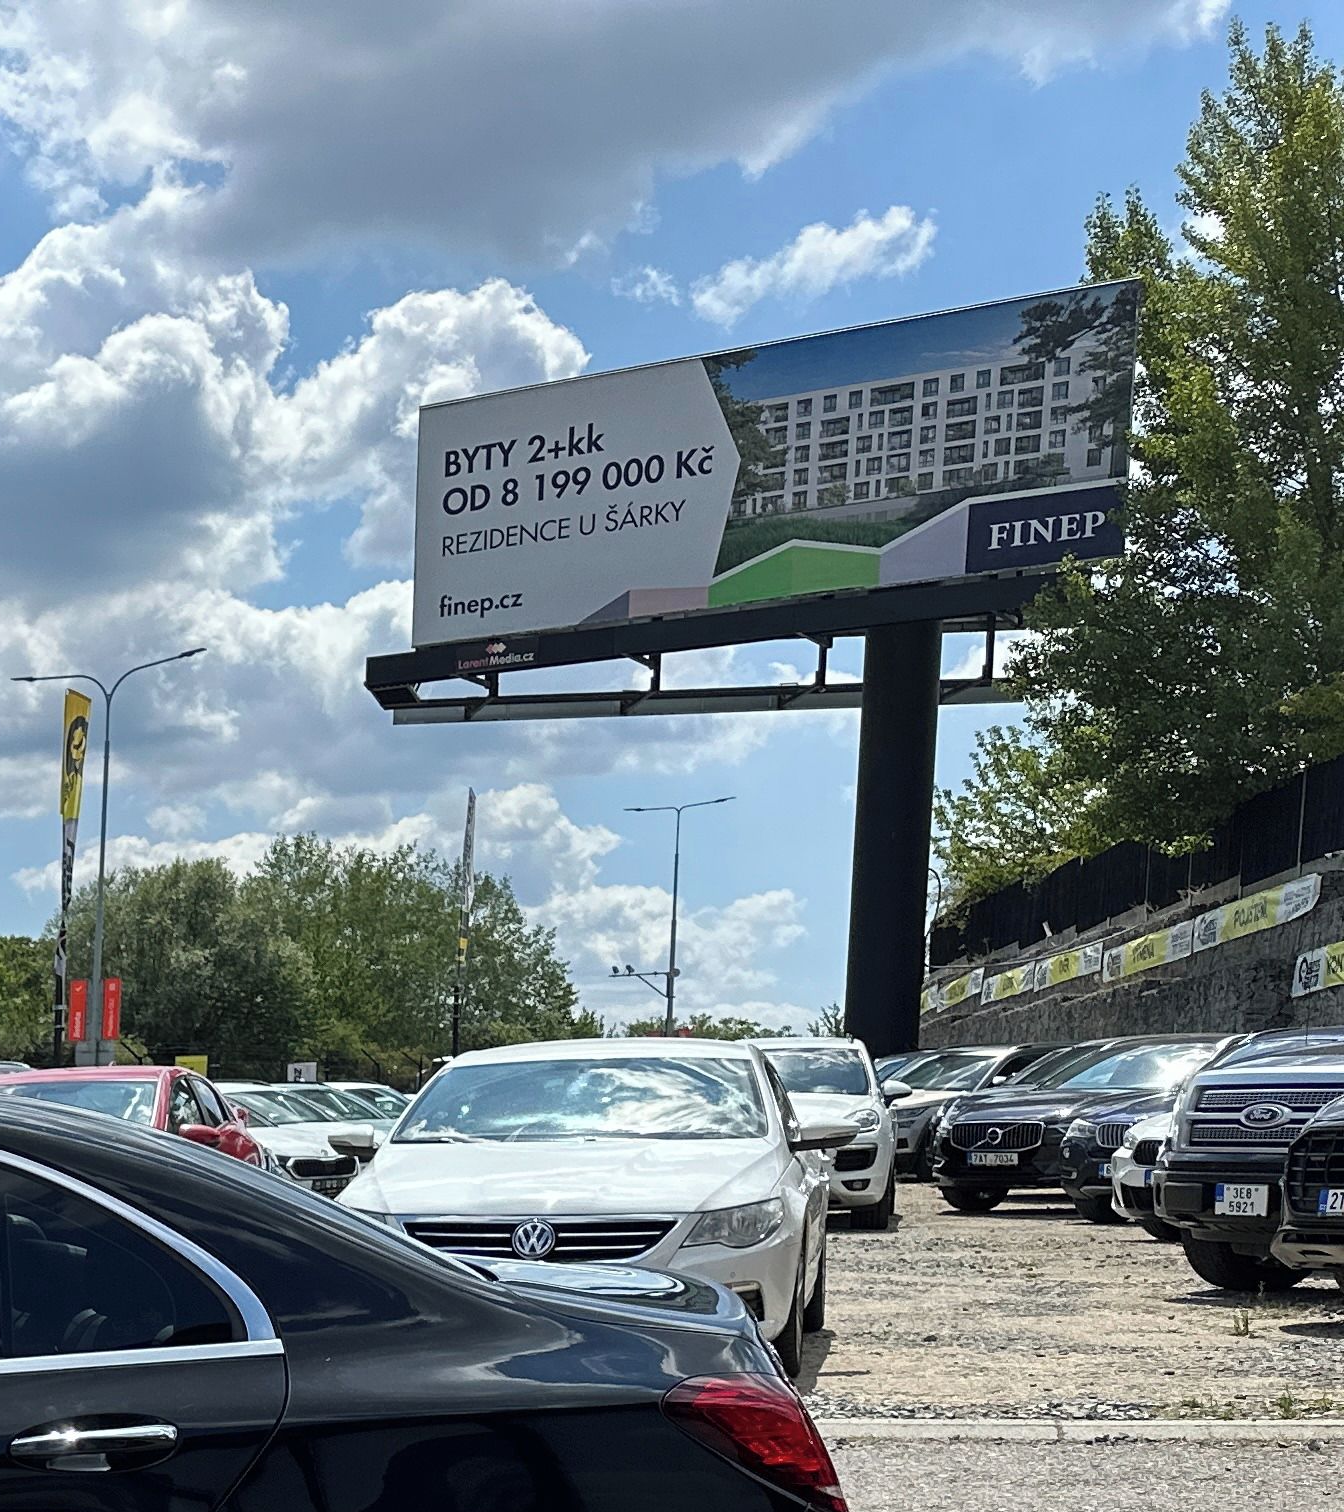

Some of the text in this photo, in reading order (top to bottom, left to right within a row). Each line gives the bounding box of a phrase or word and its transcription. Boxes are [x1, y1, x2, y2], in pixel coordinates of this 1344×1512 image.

[444, 422, 605, 478] BYTY 2+kk
[442, 445, 715, 516] OD 8 199 000 Kč
[441, 499, 687, 557] REZIDENCE U ŠÁRKY
[987, 511, 1106, 551] FINEP
[438, 592, 524, 618] finep.cz
[1228, 1201, 1255, 1214] 5921
[1232, 1186, 1253, 1199] 3E8
